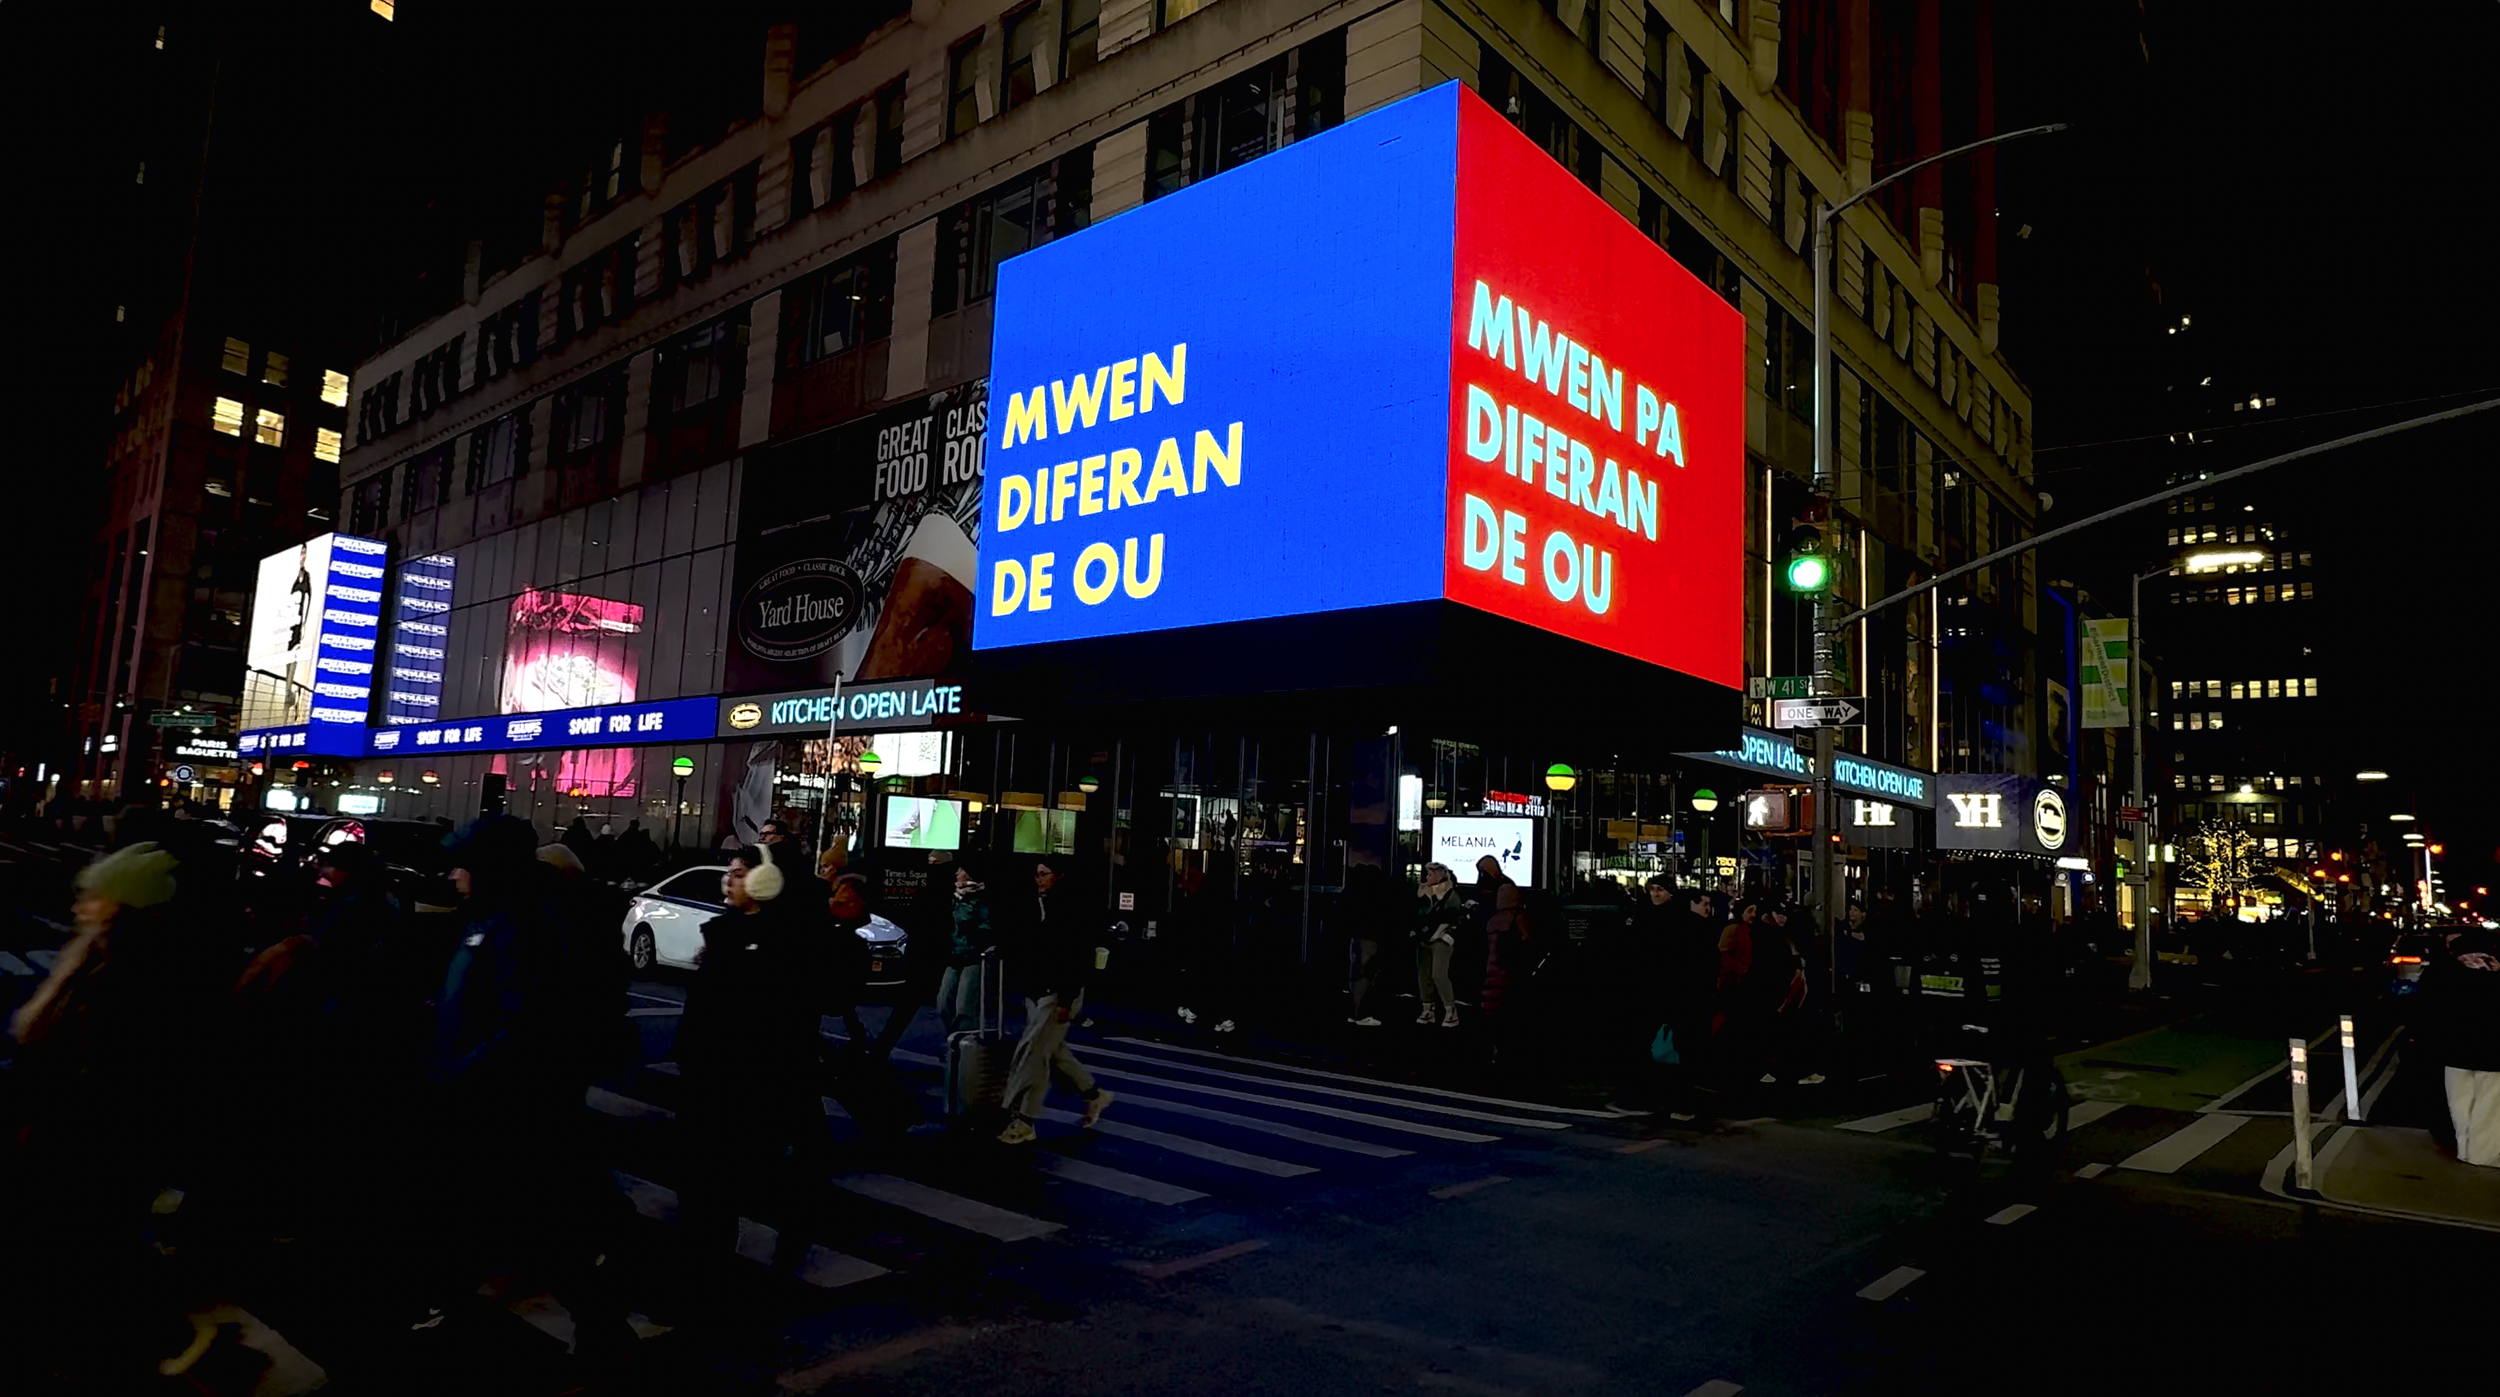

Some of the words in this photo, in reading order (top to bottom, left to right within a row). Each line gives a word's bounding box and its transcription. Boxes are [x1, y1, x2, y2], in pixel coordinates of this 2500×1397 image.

[1468, 279, 1623, 433] MWEN
[1637, 384, 1685, 468] PA
[1002, 343, 1187, 449] MWEN
[877, 415, 933, 462] GREAT
[874, 452, 929, 501] FOOD
[997, 421, 1243, 532] DIFERAN
[1467, 383, 1657, 542] DIFERAN
[1463, 492, 1526, 586] DE
[1543, 531, 1612, 615] OU
[992, 552, 1055, 616] DE
[1073, 533, 1164, 605] OU
[759, 596, 793, 628] Yard
[794, 593, 844, 624] House
[771, 696, 845, 725] KITCHEN
[850, 690, 907, 721] OPEN
[911, 685, 962, 716] LATE
[1782, 679, 1795, 695] 41
[609, 714, 632, 733] FOR
[637, 712, 664, 731] LIFE
[1788, 707, 1813, 719] ONE
[1824, 707, 1851, 718] WAY
[175, 746, 239, 759] BAGUETTE
[190, 738, 229, 749] PARIS
[464, 727, 483, 743] LIFE
[1834, 759, 1876, 790] KITCHEN
[1877, 768, 1902, 794] OPEN
[1903, 776, 1923, 800] LATE
[1947, 793, 2002, 828] YH
[1441, 836, 1497, 848] MELANIA
[883, 878, 895, 887] 42
